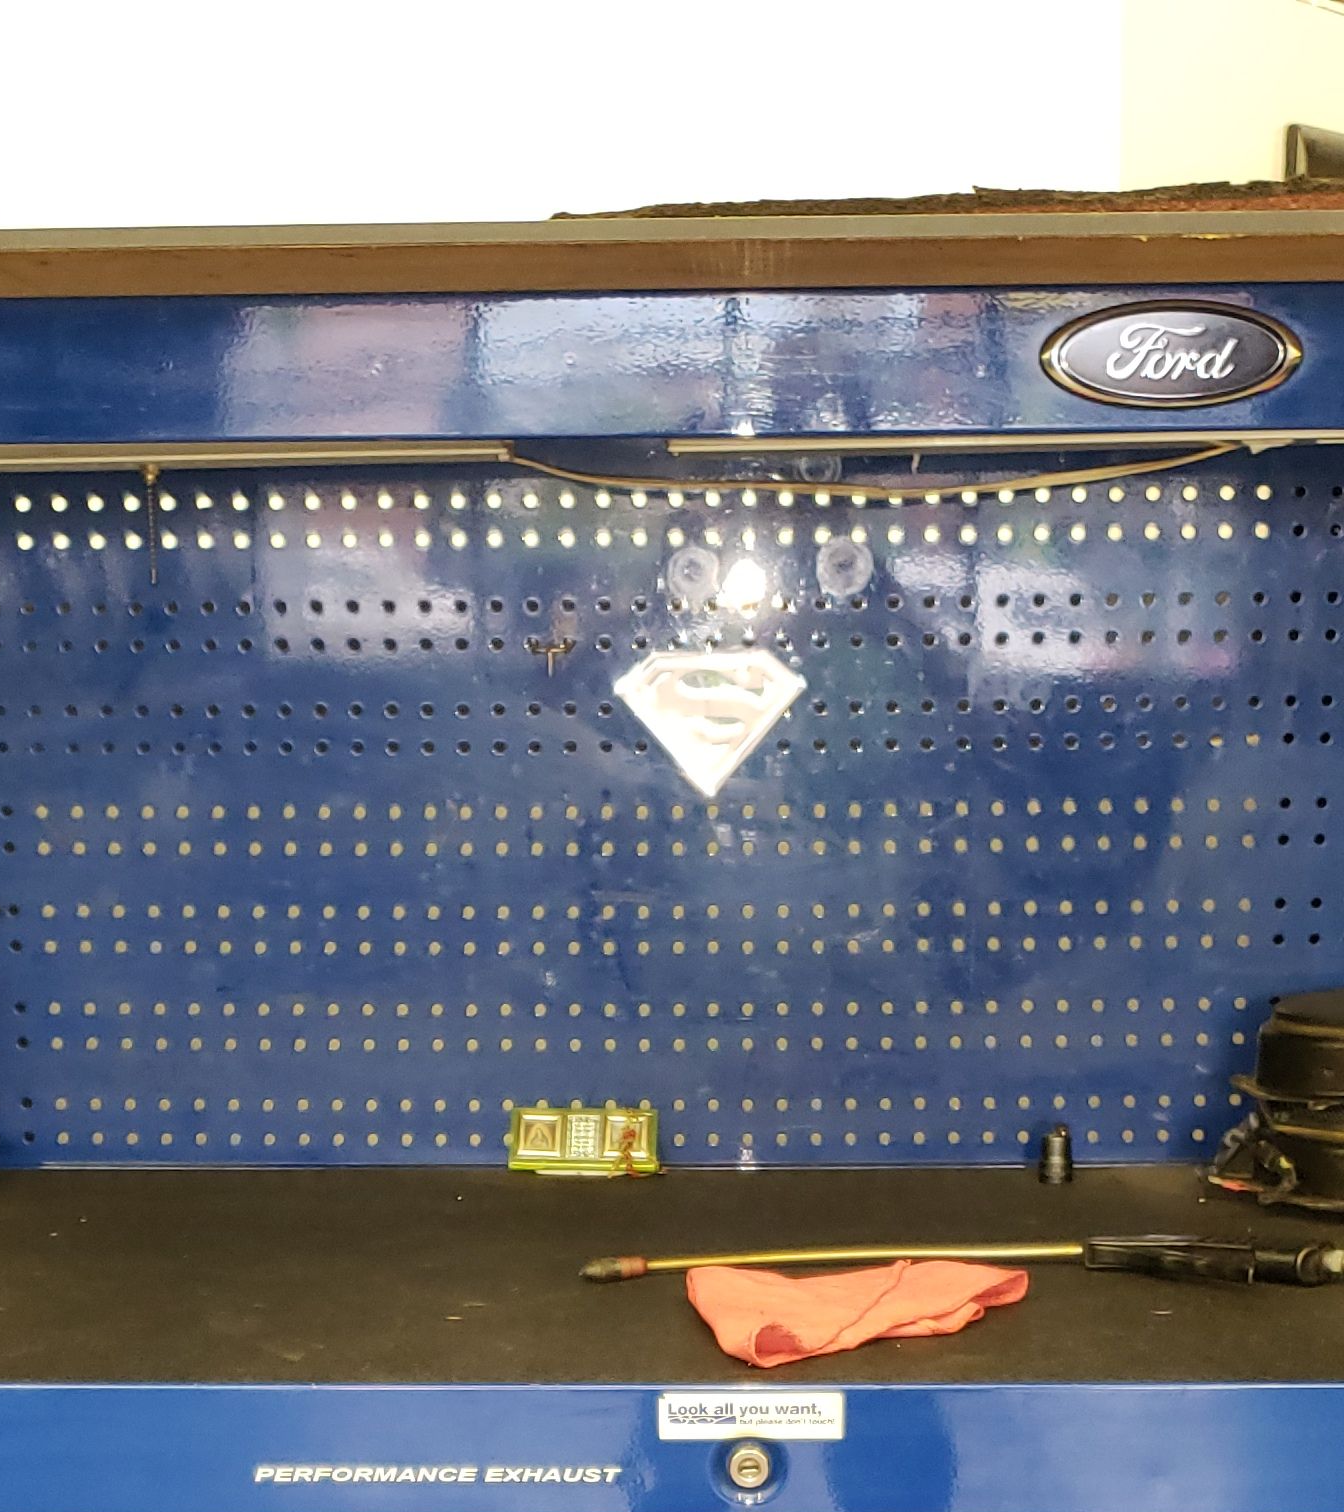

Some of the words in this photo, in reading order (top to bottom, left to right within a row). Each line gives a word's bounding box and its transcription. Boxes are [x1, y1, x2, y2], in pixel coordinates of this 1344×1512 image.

[1106, 322, 1239, 381] Ford
[667, 1402, 709, 1416] Look
[713, 1402, 735, 1415] all
[739, 1405, 770, 1418] you
[775, 1403, 823, 1417] want,
[254, 1466, 479, 1484] PERFORMANCE
[482, 1466, 624, 1484] EXHAUST
